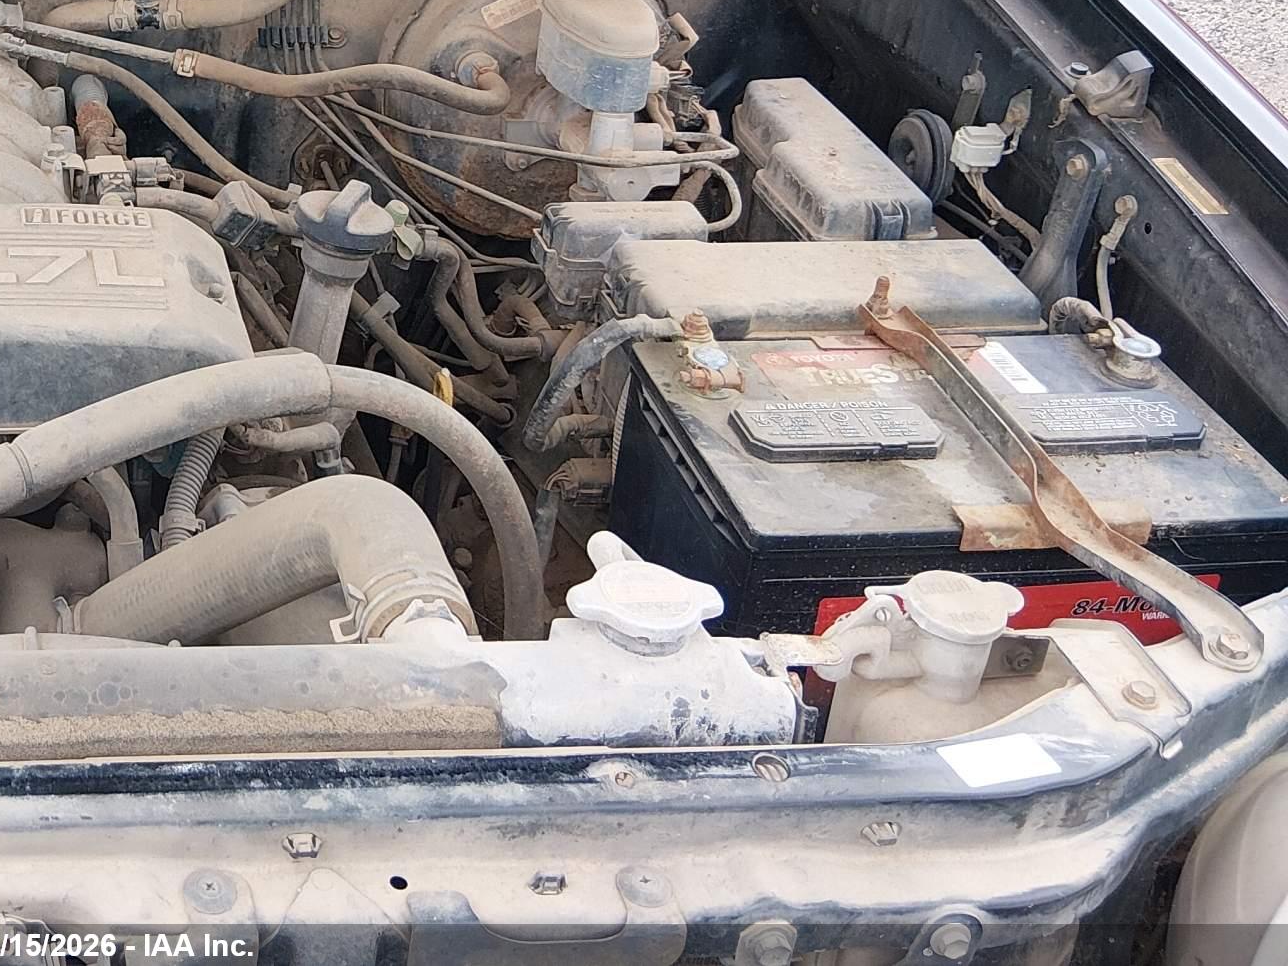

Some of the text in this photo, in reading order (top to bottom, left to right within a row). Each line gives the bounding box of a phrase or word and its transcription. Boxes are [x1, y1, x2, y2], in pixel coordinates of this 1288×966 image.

[790, 353, 857, 363] TOYOTA
[777, 402, 830, 410] DANGER
[839, 400, 889, 409] POISON
[1072, 596, 1158, 616] 84-Mo
